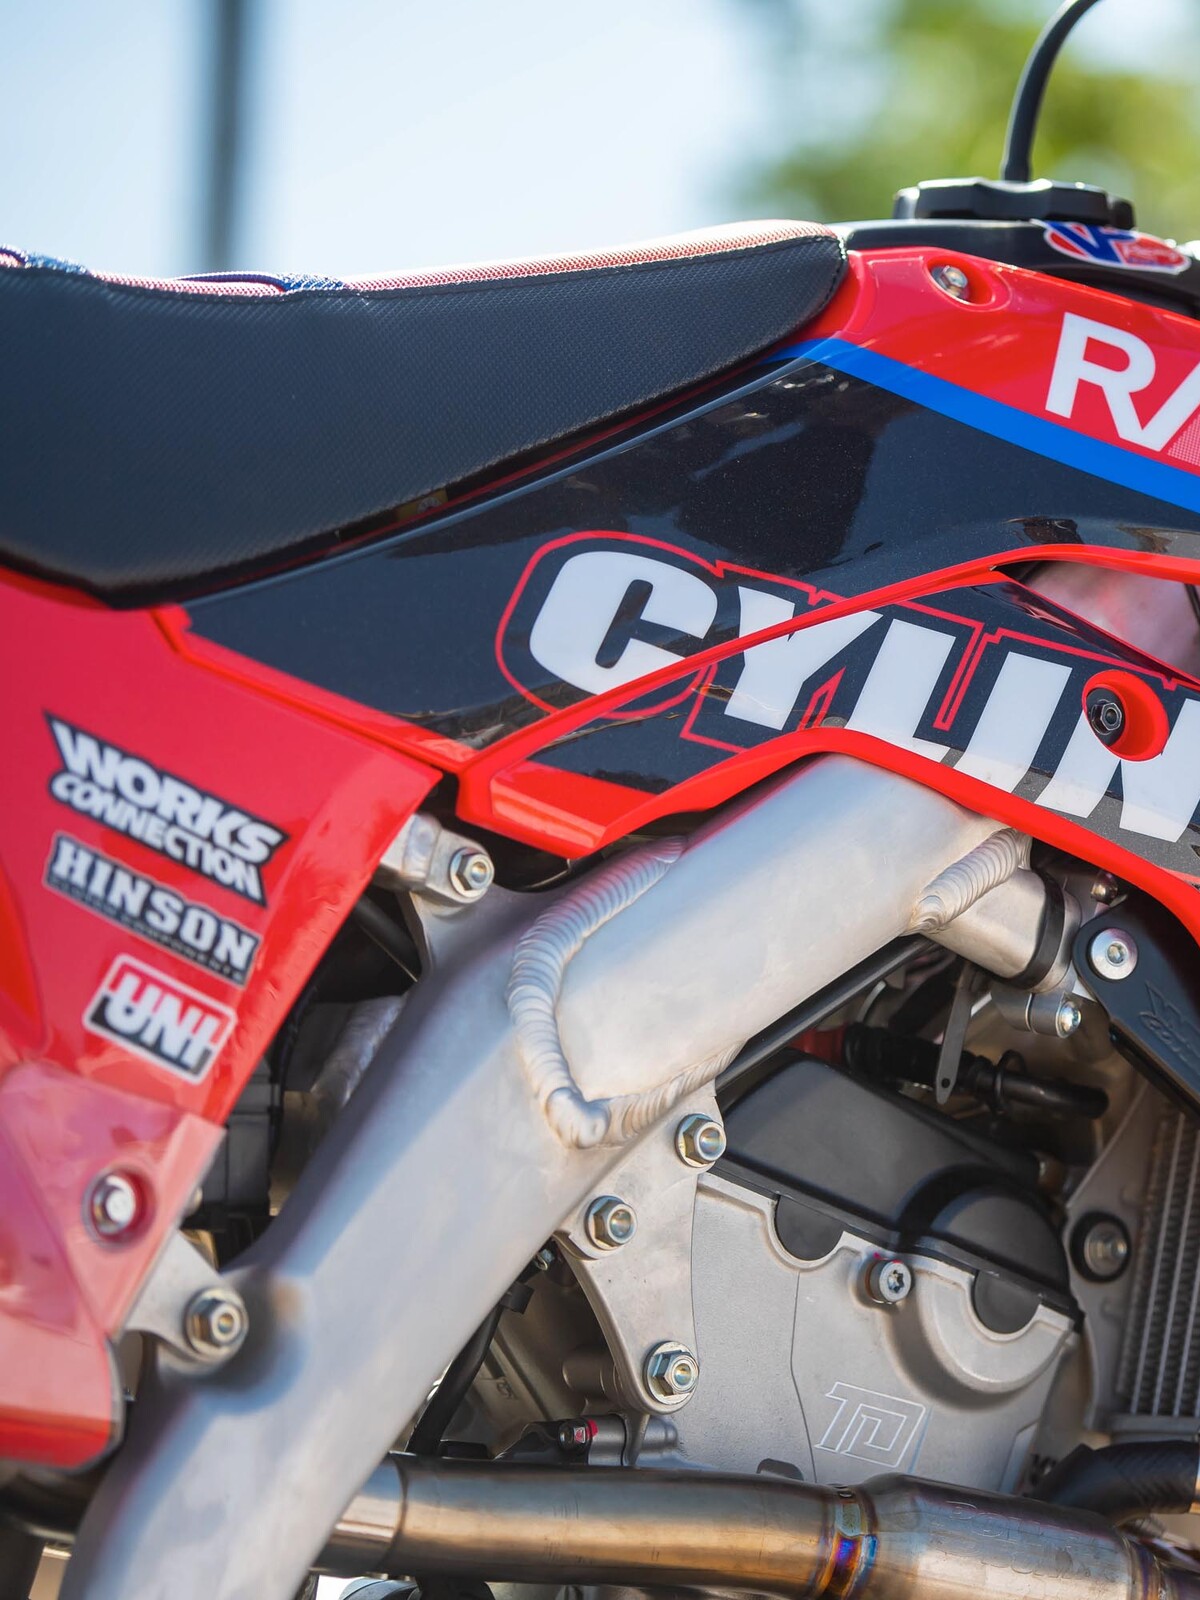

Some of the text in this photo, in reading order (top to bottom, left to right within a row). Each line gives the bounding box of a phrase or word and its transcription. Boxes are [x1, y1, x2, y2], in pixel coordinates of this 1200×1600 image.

[51, 719, 284, 863] WORKS
[51, 772, 264, 902] CONNECTION
[52, 838, 259, 970] HINSON
[104, 971, 222, 1070] UNI
